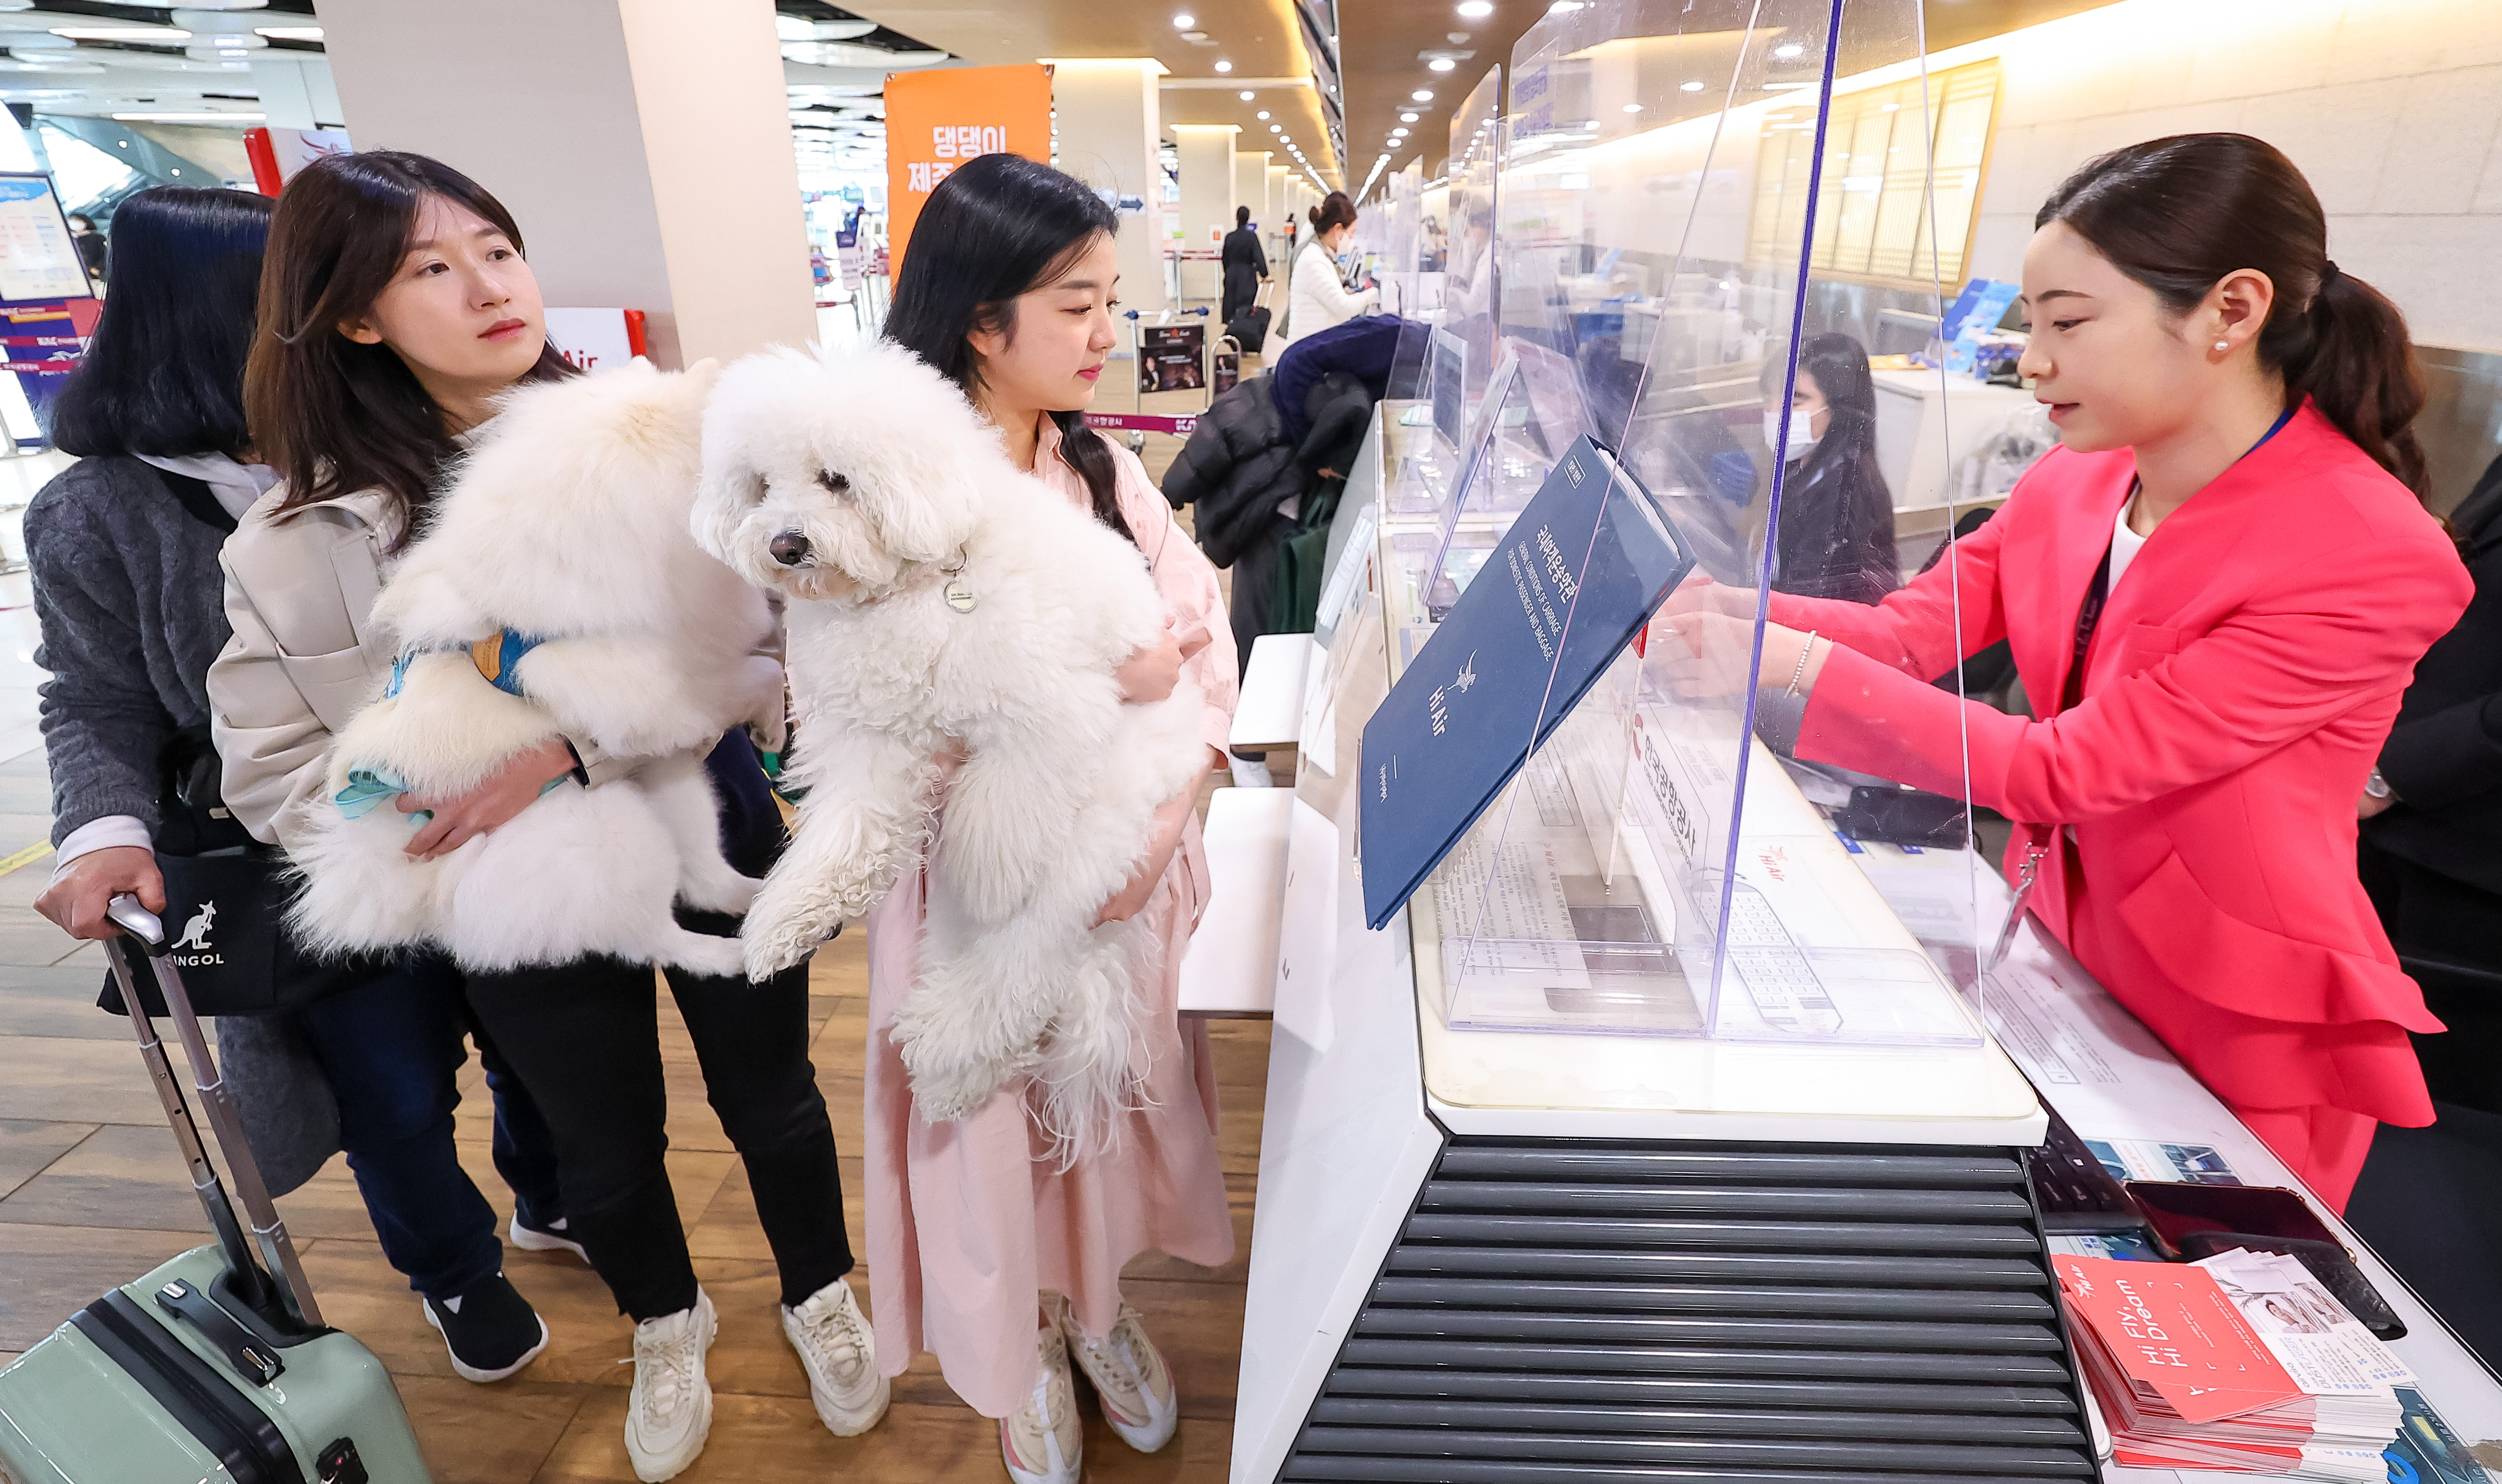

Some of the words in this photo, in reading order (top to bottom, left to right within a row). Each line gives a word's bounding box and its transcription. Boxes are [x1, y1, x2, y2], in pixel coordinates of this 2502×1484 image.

[933, 125, 1006, 158] 댕댕이
[1519, 541, 1529, 565] GENERAL
[1536, 524, 1578, 604] 국내여객운송약관
[1509, 556, 1522, 585] DOMESTIC
[1525, 560, 1543, 596] CONDITIONS
[1517, 580, 1534, 616] PASSENGER
[1538, 592, 1547, 604] OF
[1529, 612, 1540, 629] AND
[1542, 601, 1562, 636] CARRIAGE
[1534, 625, 1554, 662] BAGGAGE
[1429, 684, 1445, 712] Hi
[1431, 706, 1448, 736] Air
[1645, 734, 1696, 857] 한국공항공사
[1668, 816, 1692, 871] CORPORATION
[1758, 855, 1777, 865] Hi
[1765, 867, 1785, 881] Air
[2115, 1279, 2170, 1341] Dream
[2116, 1306, 2147, 1339] Fly,
[2136, 1345, 2166, 1365] Hi
[2159, 1347, 2189, 1367] Hi
